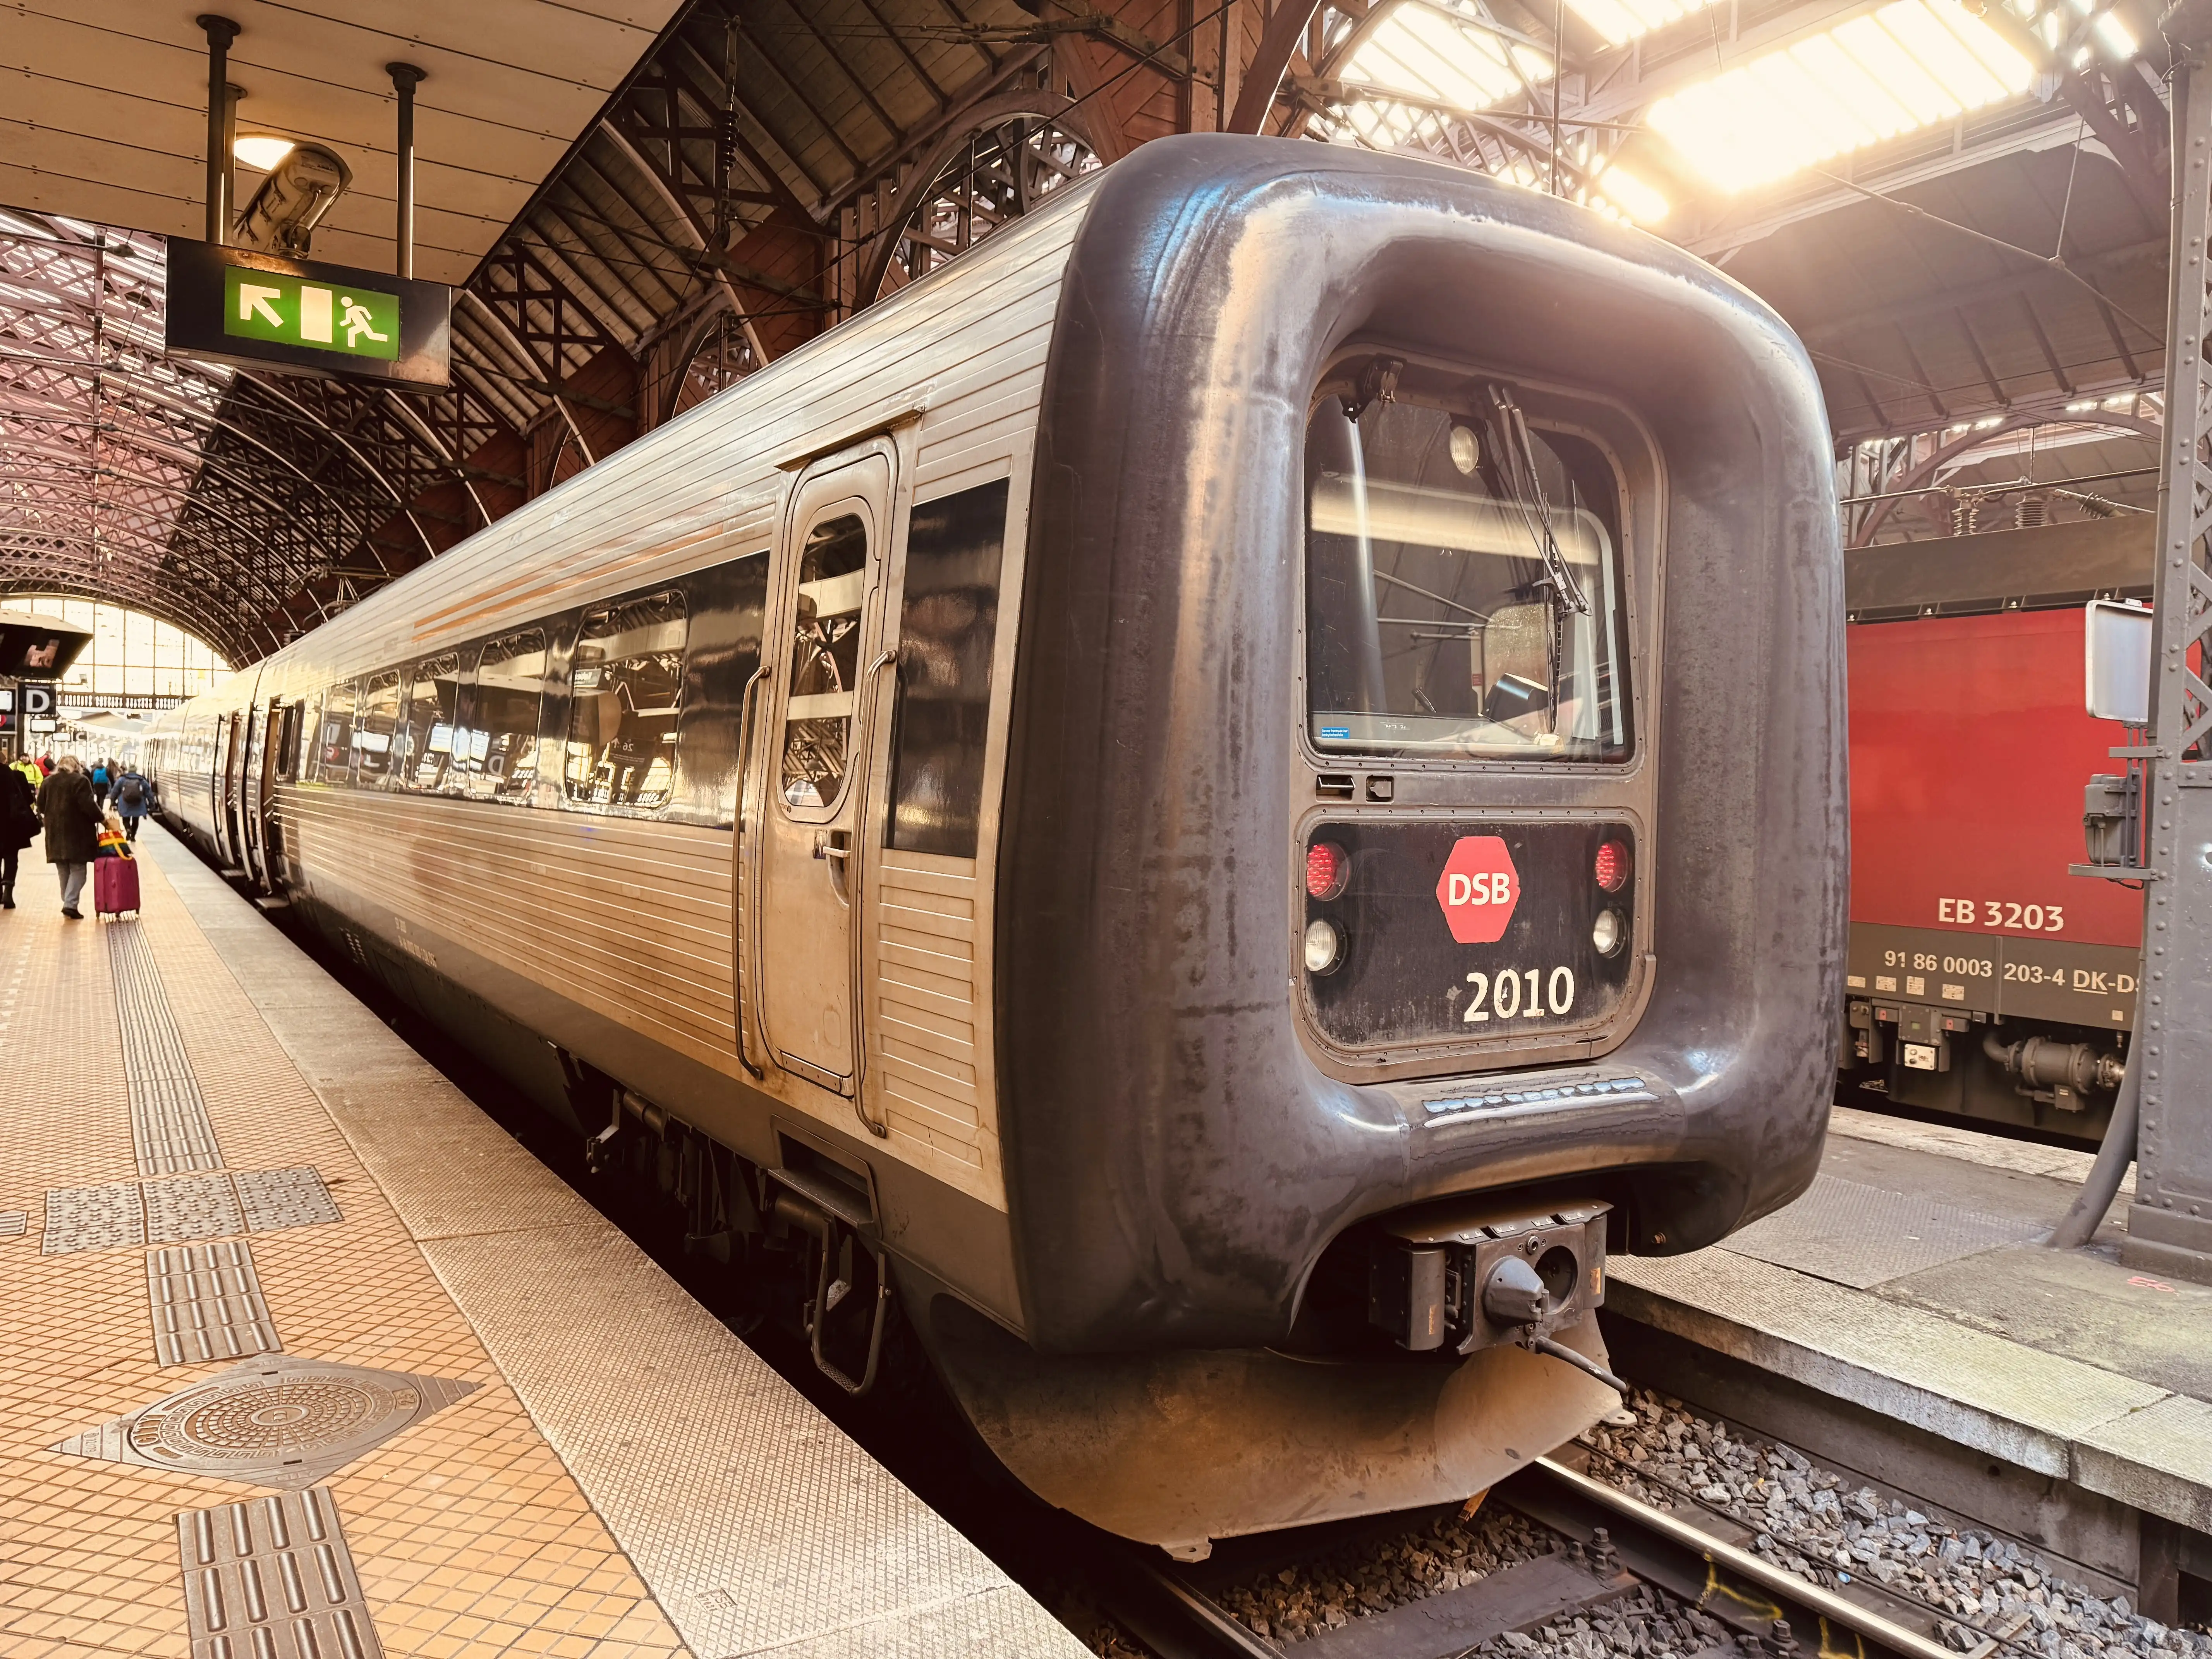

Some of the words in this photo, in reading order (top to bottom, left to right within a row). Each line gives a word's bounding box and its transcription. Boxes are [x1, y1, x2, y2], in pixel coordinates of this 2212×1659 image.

[26, 689, 50, 713] D
[1448, 873, 1511, 906] DSB
[1938, 898, 1975, 924] EB
[1984, 902, 2064, 931] 3203
[1884, 950, 1906, 968] 91
[1913, 953, 1937, 971] 86
[1943, 956, 1992, 977] 0003
[2003, 963, 2066, 986] 203-4
[1463, 966, 1575, 1022] 2010
[134, 1415, 163, 1446] CITY
